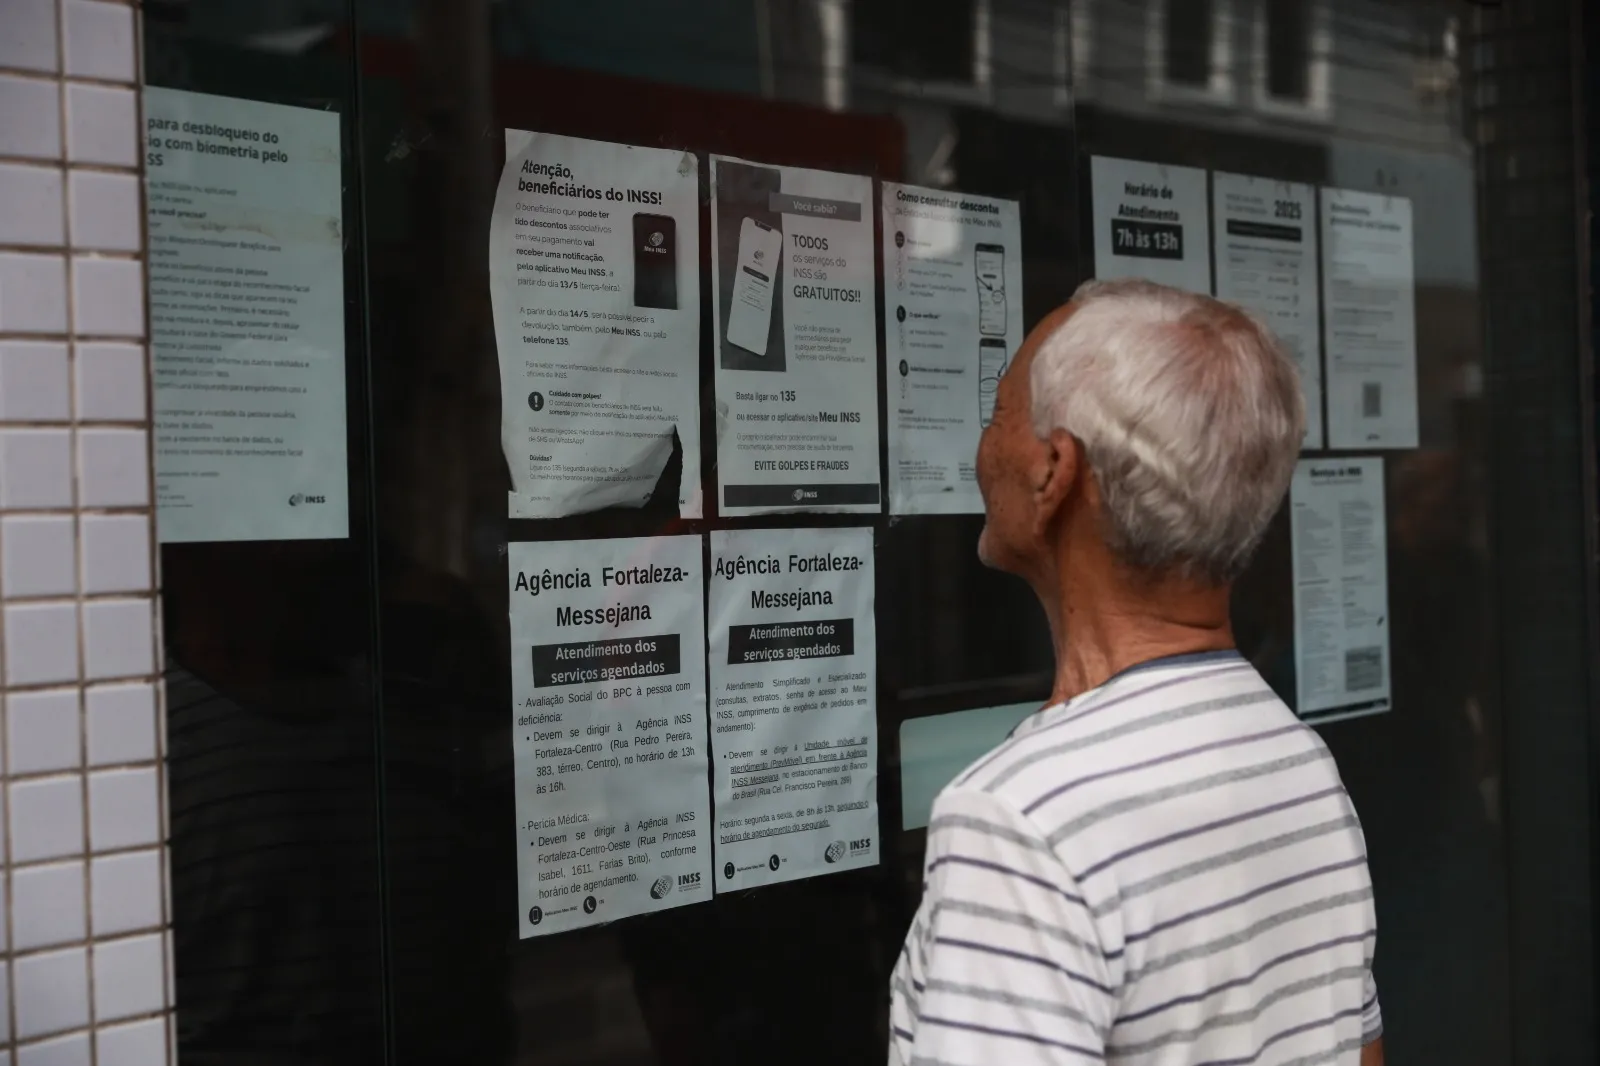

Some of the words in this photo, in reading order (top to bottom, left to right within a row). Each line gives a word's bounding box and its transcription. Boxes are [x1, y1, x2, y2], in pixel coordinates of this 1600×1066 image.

[148, 118, 178, 131] para
[182, 122, 259, 141] desbloqueio
[263, 131, 278, 144] do
[165, 138, 193, 151] com
[197, 140, 259, 159] biometria
[262, 151, 288, 164] pelo
[521, 159, 574, 180] Atenção,
[518, 177, 602, 199] beneficiários
[606, 188, 623, 201] do
[627, 189, 662, 205] INSS!
[897, 190, 918, 203] Como
[920, 197, 958, 208] consultar
[1125, 182, 1158, 199] Horário
[1161, 185, 1173, 200] de
[563, 208, 576, 216] que
[578, 209, 597, 218] pode
[793, 201, 811, 211] Você
[813, 203, 837, 214] sabia?
[1118, 204, 1179, 222] Atendimento
[515, 218, 528, 226] tido
[530, 219, 567, 230] descontos
[569, 223, 611, 233] associativos
[542, 235, 582, 246] pagamento
[792, 234, 829, 250] TODOS
[1117, 228, 1133, 247] 7h
[1136, 230, 1150, 248] às
[1153, 232, 1179, 250] 13h
[516, 248, 543, 257] receber
[562, 251, 604, 262] notificação,
[804, 255, 834, 267] serviços
[836, 258, 846, 267] do
[517, 263, 533, 271] pelo
[535, 265, 569, 274] aplicativo
[794, 269, 812, 279] INSS
[814, 269, 827, 280] são
[537, 278, 546, 286] do
[547, 279, 558, 287] dia
[560, 281, 578, 289] 13/5
[794, 286, 861, 303] GRATUITOS!!
[523, 336, 555, 344] telefone
[736, 392, 754, 400] Basta
[755, 392, 768, 402] ligar
[780, 391, 795, 402] 135
[777, 414, 818, 422] aplicativo/site
[819, 412, 837, 422] Meu
[840, 412, 860, 422] INSS
[754, 461, 776, 470] EVITE
[778, 461, 808, 470] GOLPES
[811, 461, 815, 470] E
[817, 461, 849, 470] FRAUDES
[305, 495, 326, 504] INSS
[715, 555, 781, 580] Agência
[789, 553, 863, 573] Fortaleza-
[515, 567, 591, 596] Agência
[602, 564, 688, 586] Fortaleza-
[751, 588, 833, 611] Messejana
[556, 602, 651, 628] Messejana
[749, 625, 814, 640] Atendimento
[816, 623, 835, 635] dos
[556, 642, 632, 661] Atendimento
[635, 640, 656, 653] dos
[744, 648, 783, 662] serviços
[787, 643, 841, 659] agendados
[551, 667, 598, 684] serviços
[601, 661, 665, 680] agendados
[726, 681, 764, 691] Atendimento
[772, 677, 810, 688] Simplificado
[526, 694, 564, 708] Avaliação
[568, 691, 592, 703] Social
[597, 690, 608, 700] do
[613, 688, 632, 698] BPC
[636, 687, 642, 696] à
[646, 685, 672, 696] pessoa
[675, 682, 691, 692] com
[753, 694, 782, 702] extratos,
[786, 691, 804, 699] senha
[819, 687, 836, 696] acesso
[518, 713, 563, 726] deficiência:
[533, 729, 563, 742] Devem
[569, 728, 580, 738] se
[586, 723, 610, 736] dirigir
[617, 721, 623, 732] à
[636, 717, 668, 730] Agência
[674, 714, 692, 725] INSS
[535, 743, 603, 759] Fortaleza-Centro
[610, 740, 629, 752] (Rua
[634, 735, 659, 748] Pedro
[666, 731, 692, 743] Pereira,
[536, 766, 554, 777] 383,
[558, 763, 583, 774] térreo,
[586, 757, 621, 771] Centro),
[624, 756, 633, 765] no
[636, 751, 665, 764] horário
[668, 749, 678, 759] de
[681, 747, 695, 757] 13h
[536, 783, 547, 795] às
[549, 782, 566, 793] 16h.
[558, 813, 590, 826] Médica:
[538, 834, 567, 848] Devem
[576, 832, 586, 841] se
[594, 826, 615, 838] dirigir
[624, 823, 630, 833] à
[638, 817, 668, 831] Agência
[676, 811, 695, 823] INSS
[538, 840, 630, 865] Fortaleza-Centro-Oeste
[637, 836, 656, 848] (Rua
[663, 828, 696, 843] Princesa
[850, 838, 871, 850] INSS
[538, 869, 566, 882] Isabel,
[599, 859, 623, 872] Farias
[628, 854, 651, 867] Brito),
[661, 845, 696, 860] conforme
[538, 883, 569, 900] horário
[571, 881, 581, 893] de
[583, 874, 639, 892] agendamento.
[678, 872, 700, 885] INSS
